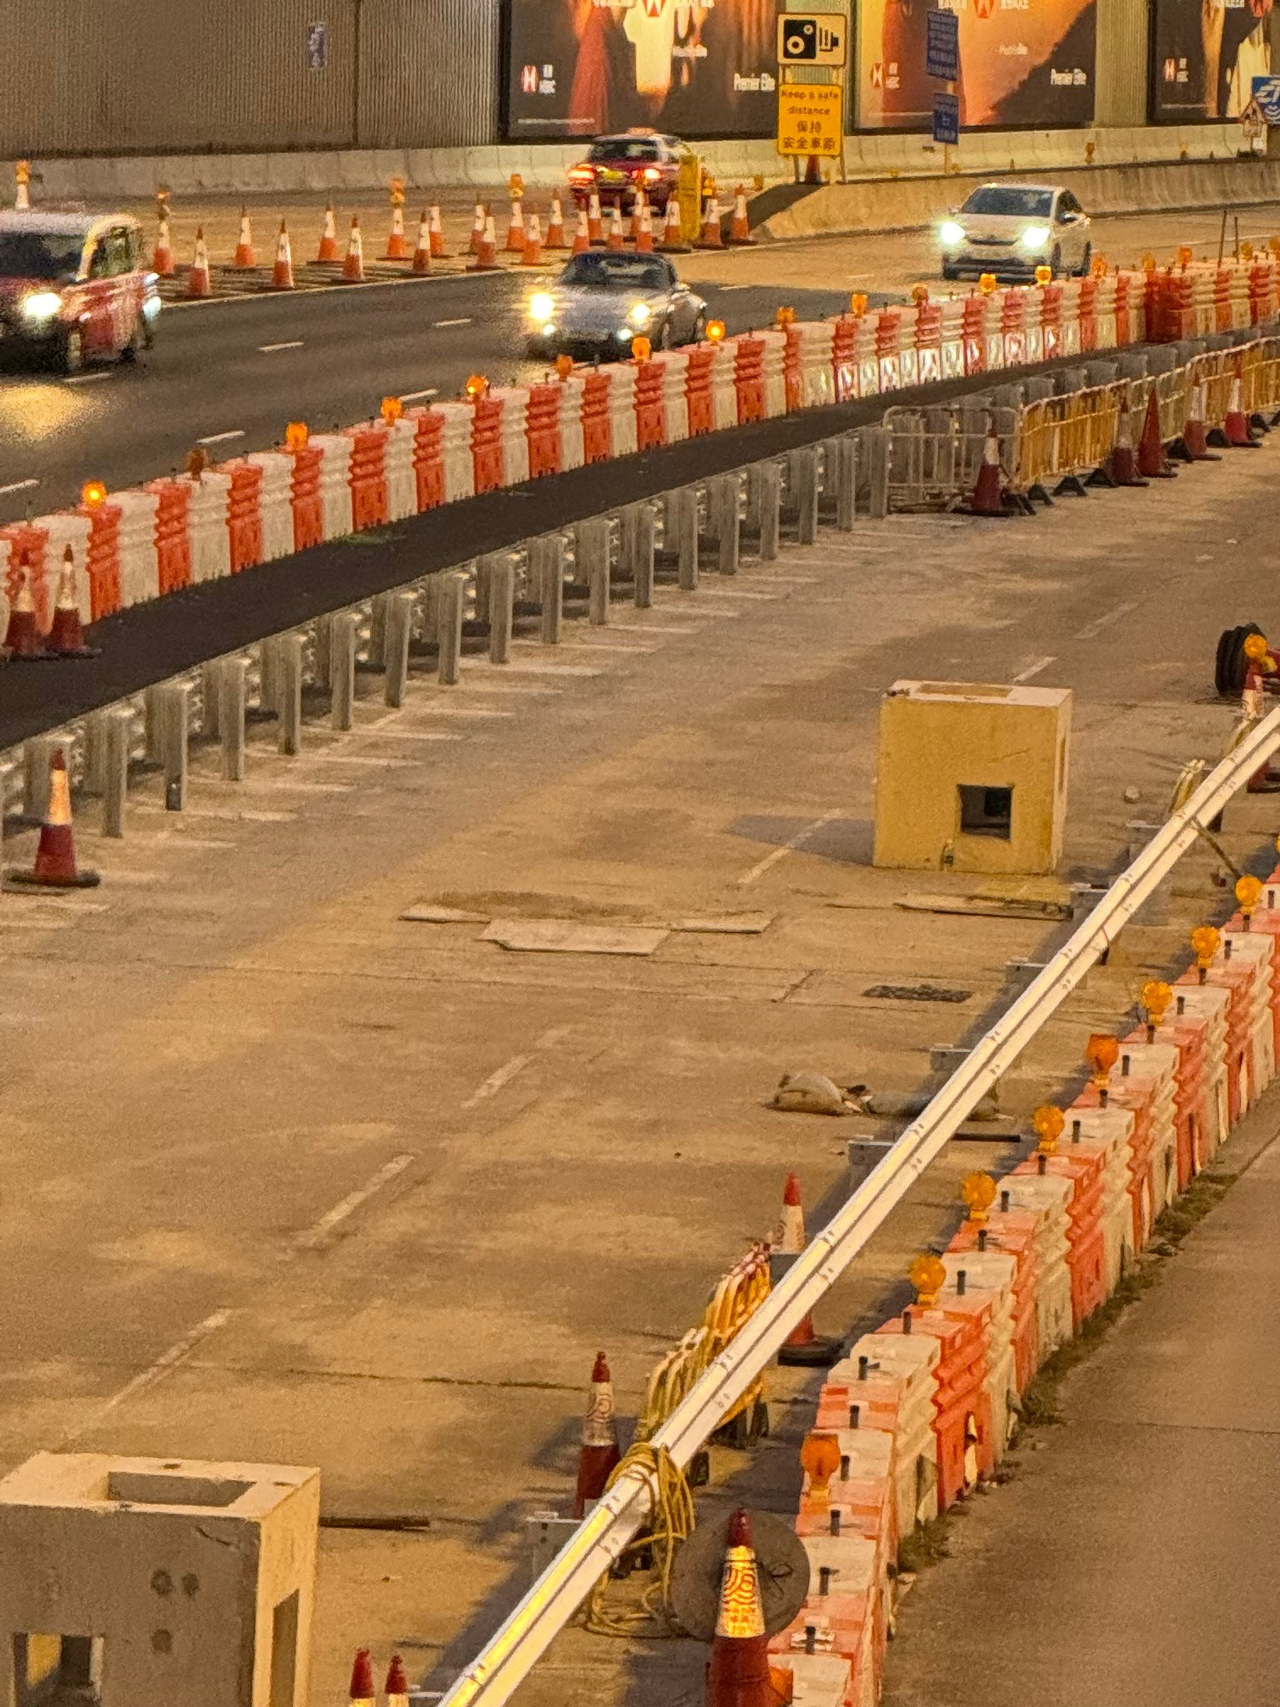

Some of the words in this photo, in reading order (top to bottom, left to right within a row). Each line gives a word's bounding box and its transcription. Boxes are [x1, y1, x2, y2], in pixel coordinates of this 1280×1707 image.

[781, 89, 806, 102] Keep
[817, 90, 839, 101] safe
[788, 105, 831, 116] distance
[796, 120, 822, 134] 保持
